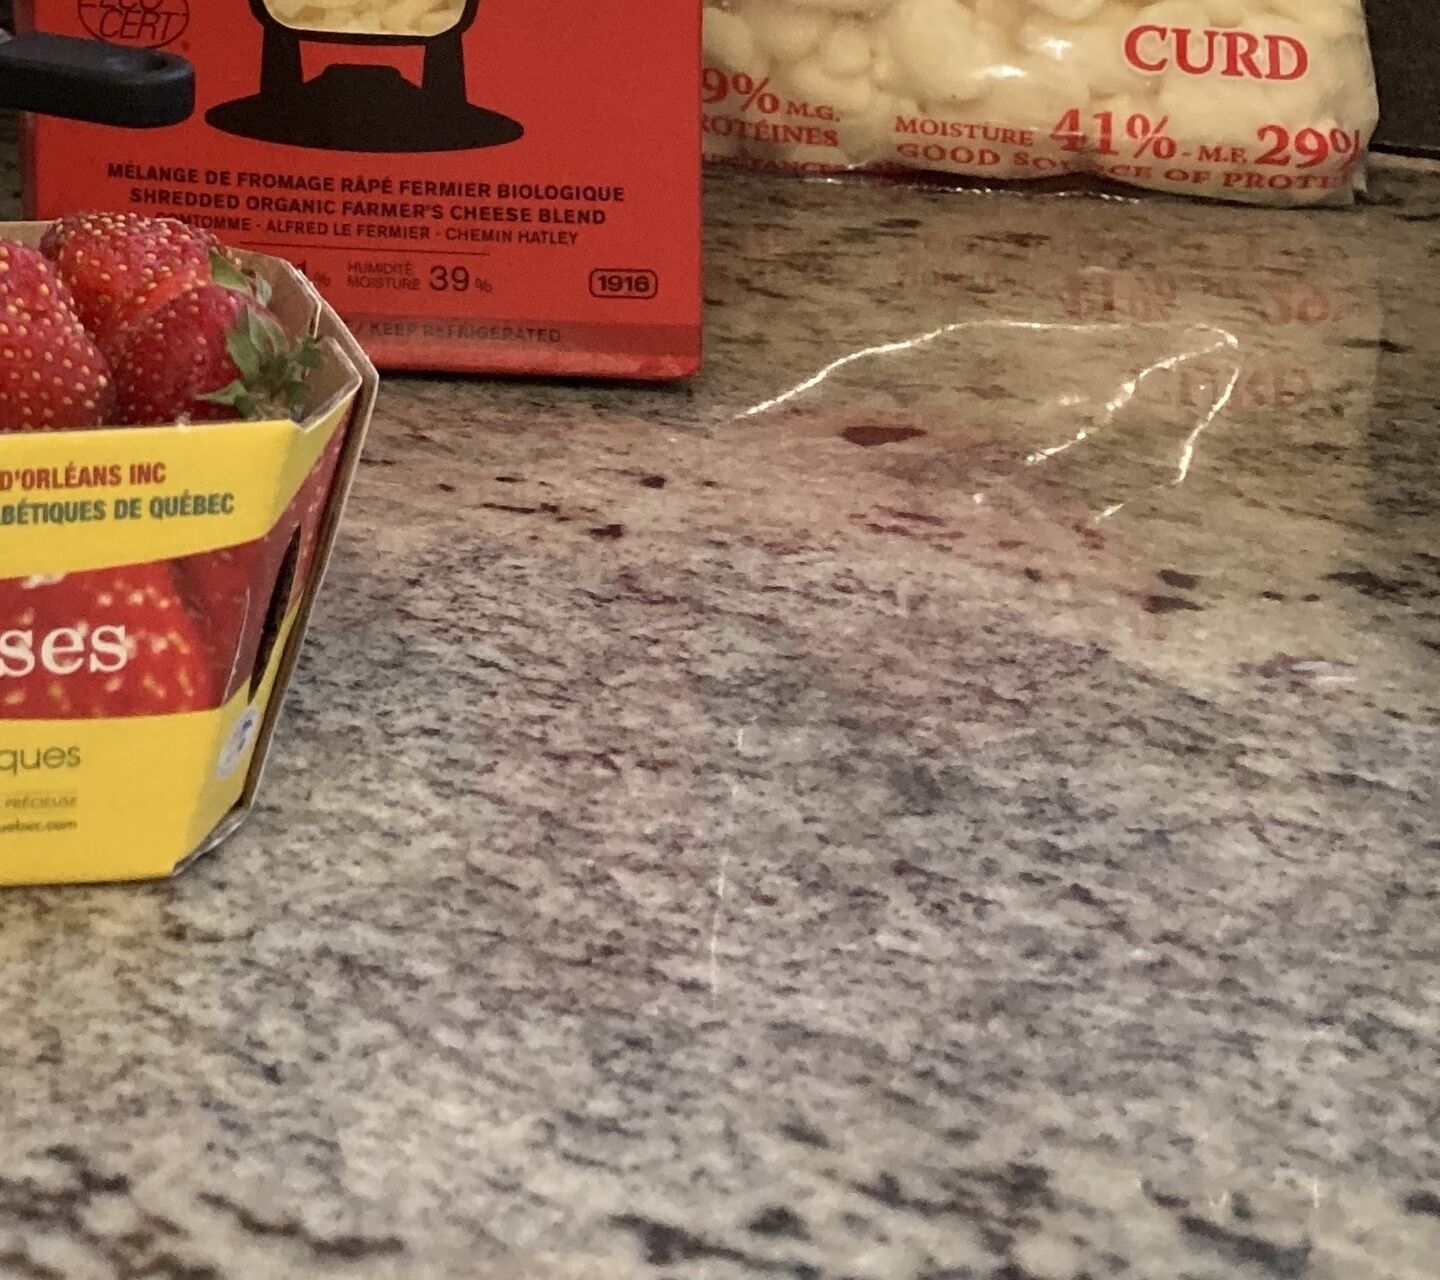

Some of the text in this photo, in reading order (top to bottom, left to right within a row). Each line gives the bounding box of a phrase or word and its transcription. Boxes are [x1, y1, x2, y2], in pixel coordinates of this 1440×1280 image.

[100, 7, 180, 42] CERT
[1123, 23, 1310, 82] CURD
[703, 67, 781, 114] 9%
[703, 113, 840, 148] ROTÉINES
[894, 115, 1034, 147] MOISTURE
[1049, 107, 1179, 162] 41%
[896, 142, 1001, 168] GOOD
[1163, 167, 1213, 185] OF
[205, 169, 232, 187] DE
[237, 171, 335, 193] FROMAGE
[399, 178, 492, 199] FERMIER
[497, 182, 626, 203] BIOLOGIQUE
[129, 186, 607, 226] SHREDDED ORGANIC FARMER'S CHEESE BLEND
[266, 219, 329, 236] ALFRED
[333, 222, 352, 236] LE
[356, 224, 431, 241] FERMIER
[445, 227, 513, 244] CHEMIN
[517, 230, 580, 247] HATLEY
[429, 264, 471, 293] 39
[369, 321, 418, 338] KEEP
[129, 461, 167, 486] INC
[113, 496, 144, 521] DE
[149, 490, 236, 520] QUÉBEC
